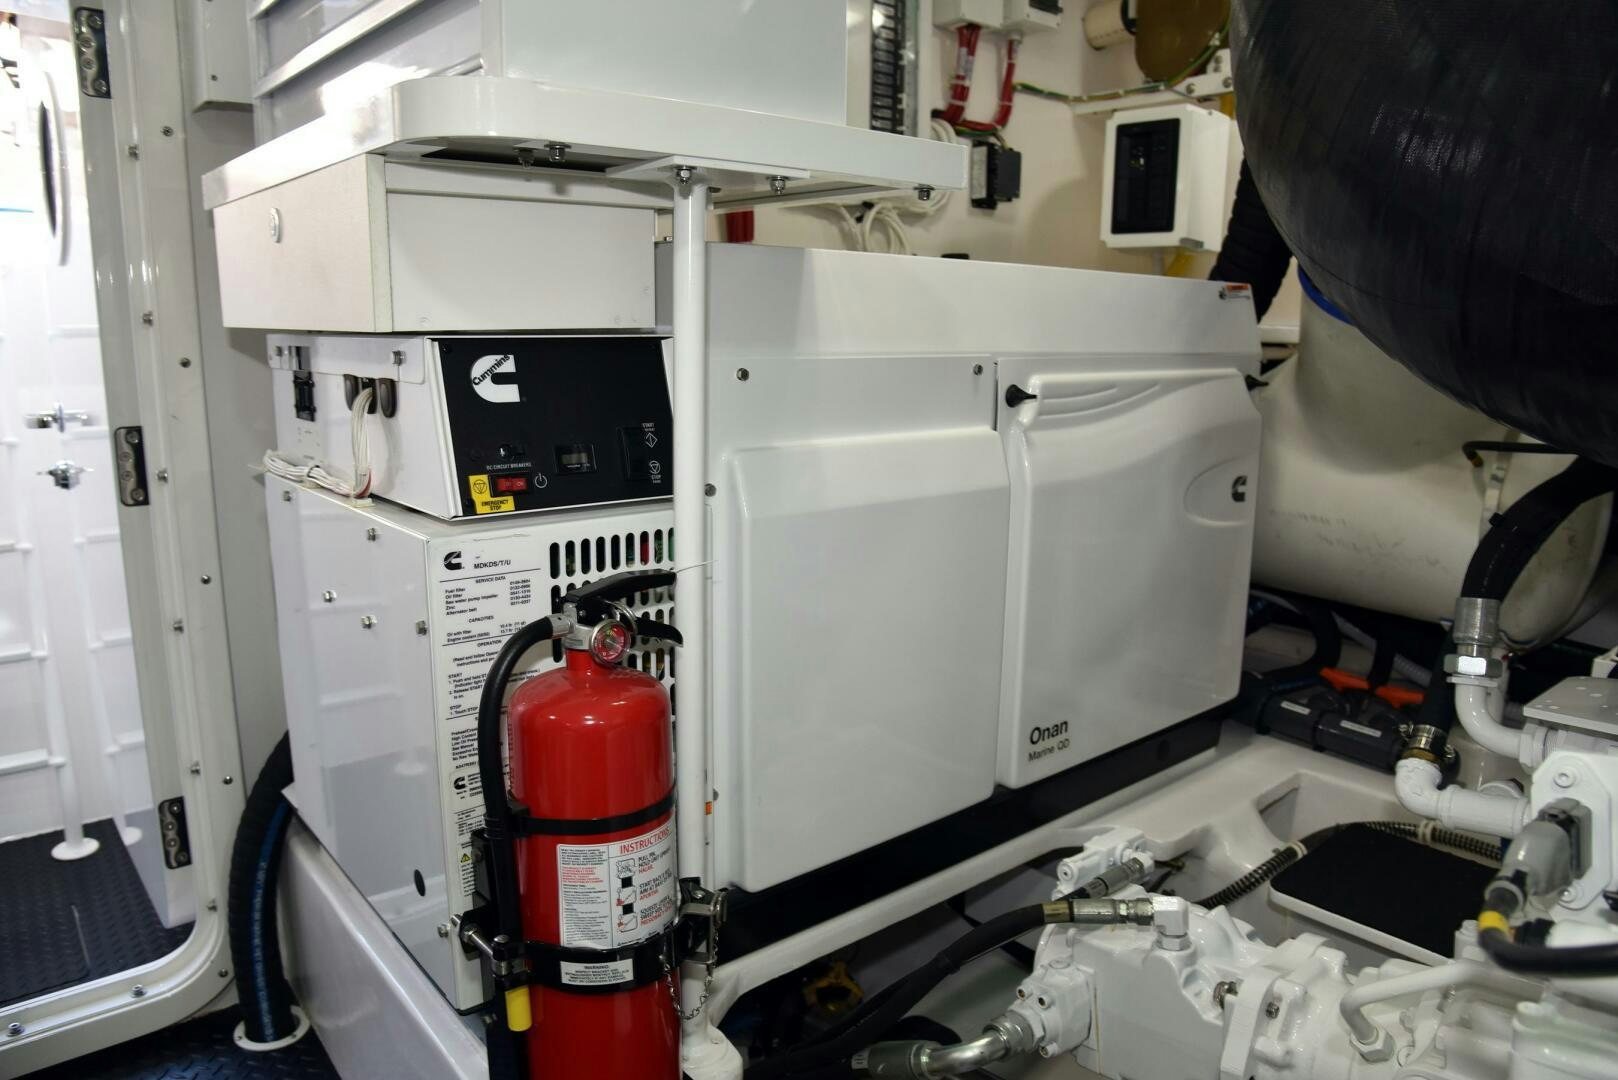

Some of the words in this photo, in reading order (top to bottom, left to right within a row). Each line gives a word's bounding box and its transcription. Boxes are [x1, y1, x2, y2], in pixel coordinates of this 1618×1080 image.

[472, 354, 511, 386] Cummins
[481, 499, 509, 507] EMERGENCY
[473, 559, 512, 569] MDKDS/T/U
[468, 615, 494, 623] CAPACITIES
[477, 639, 502, 648] OPERATION
[1030, 720, 1069, 745] Onan
[1028, 746, 1055, 762] Marine
[1057, 738, 1070, 751] QD
[620, 825, 670, 855] INSTRUCTIONS
